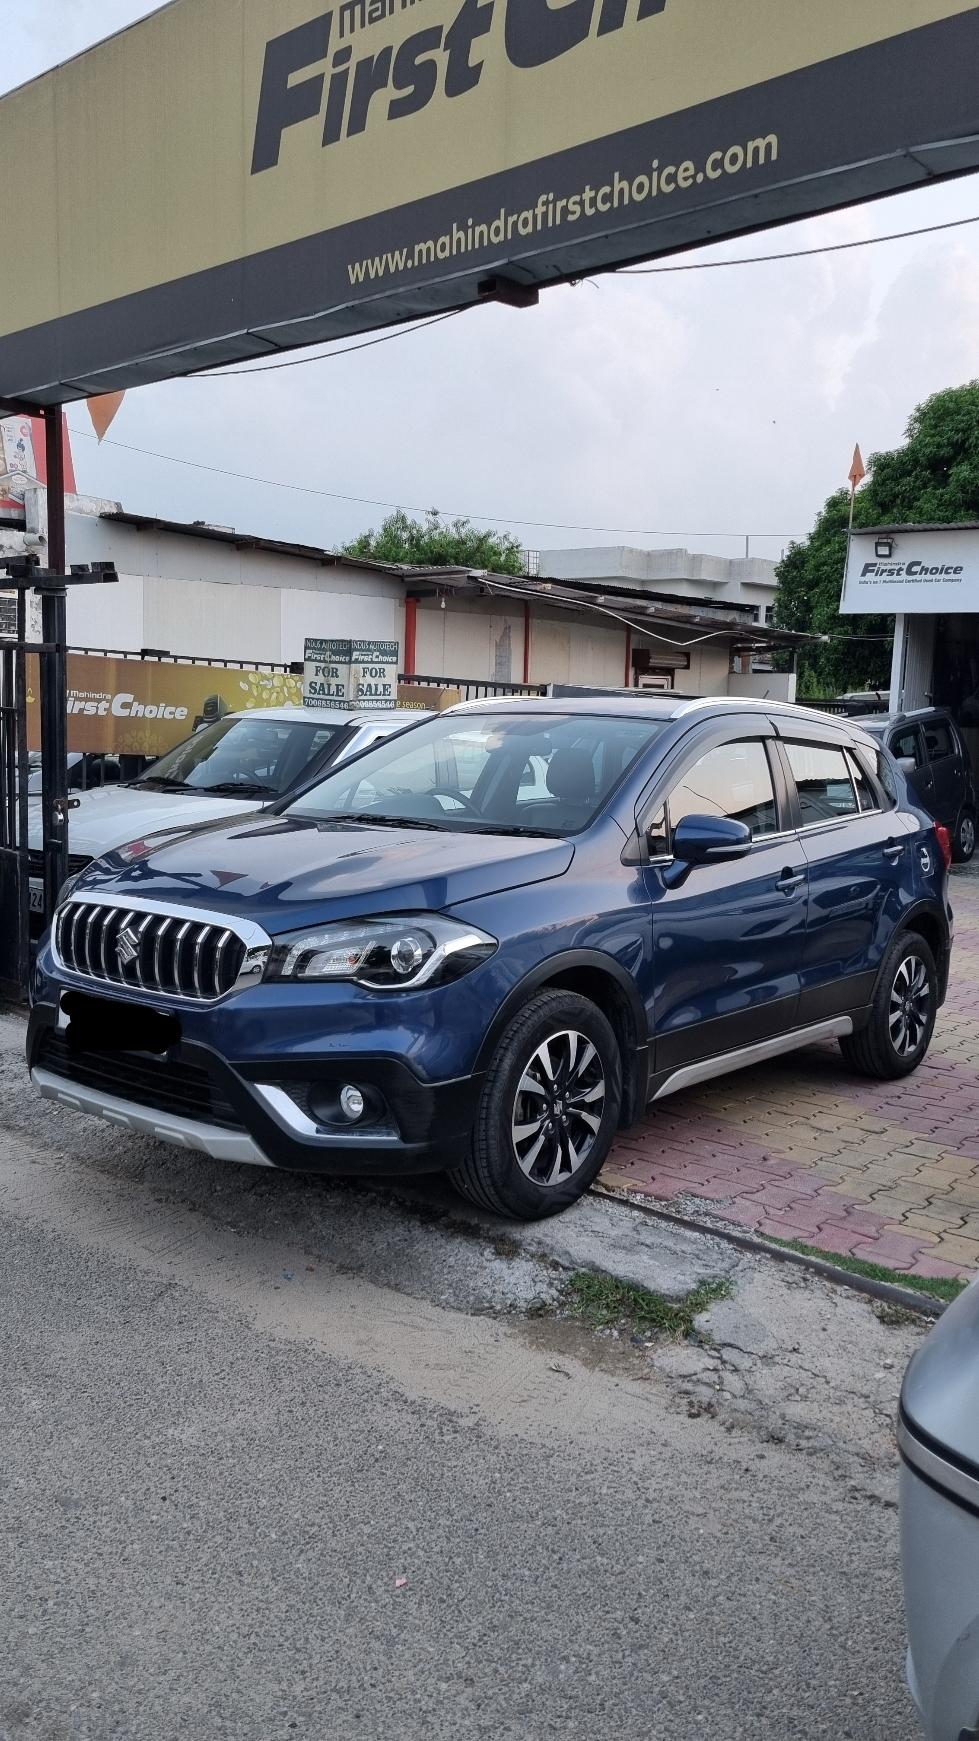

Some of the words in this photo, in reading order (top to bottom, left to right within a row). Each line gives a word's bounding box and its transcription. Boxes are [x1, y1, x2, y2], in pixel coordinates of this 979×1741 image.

[251, 0, 495, 175] First
[347, 133, 779, 285] www.mahindrafirstchoice.com
[369, 642, 398, 651] AUTOTECH
[314, 665, 340, 678] FOR
[361, 666, 386, 678] FOR
[70, 690, 112, 700] Mahindra
[308, 681, 345, 697] SALE
[357, 683, 391, 697] SALE
[66, 697, 110, 716] irst
[111, 693, 188, 719] Choice
